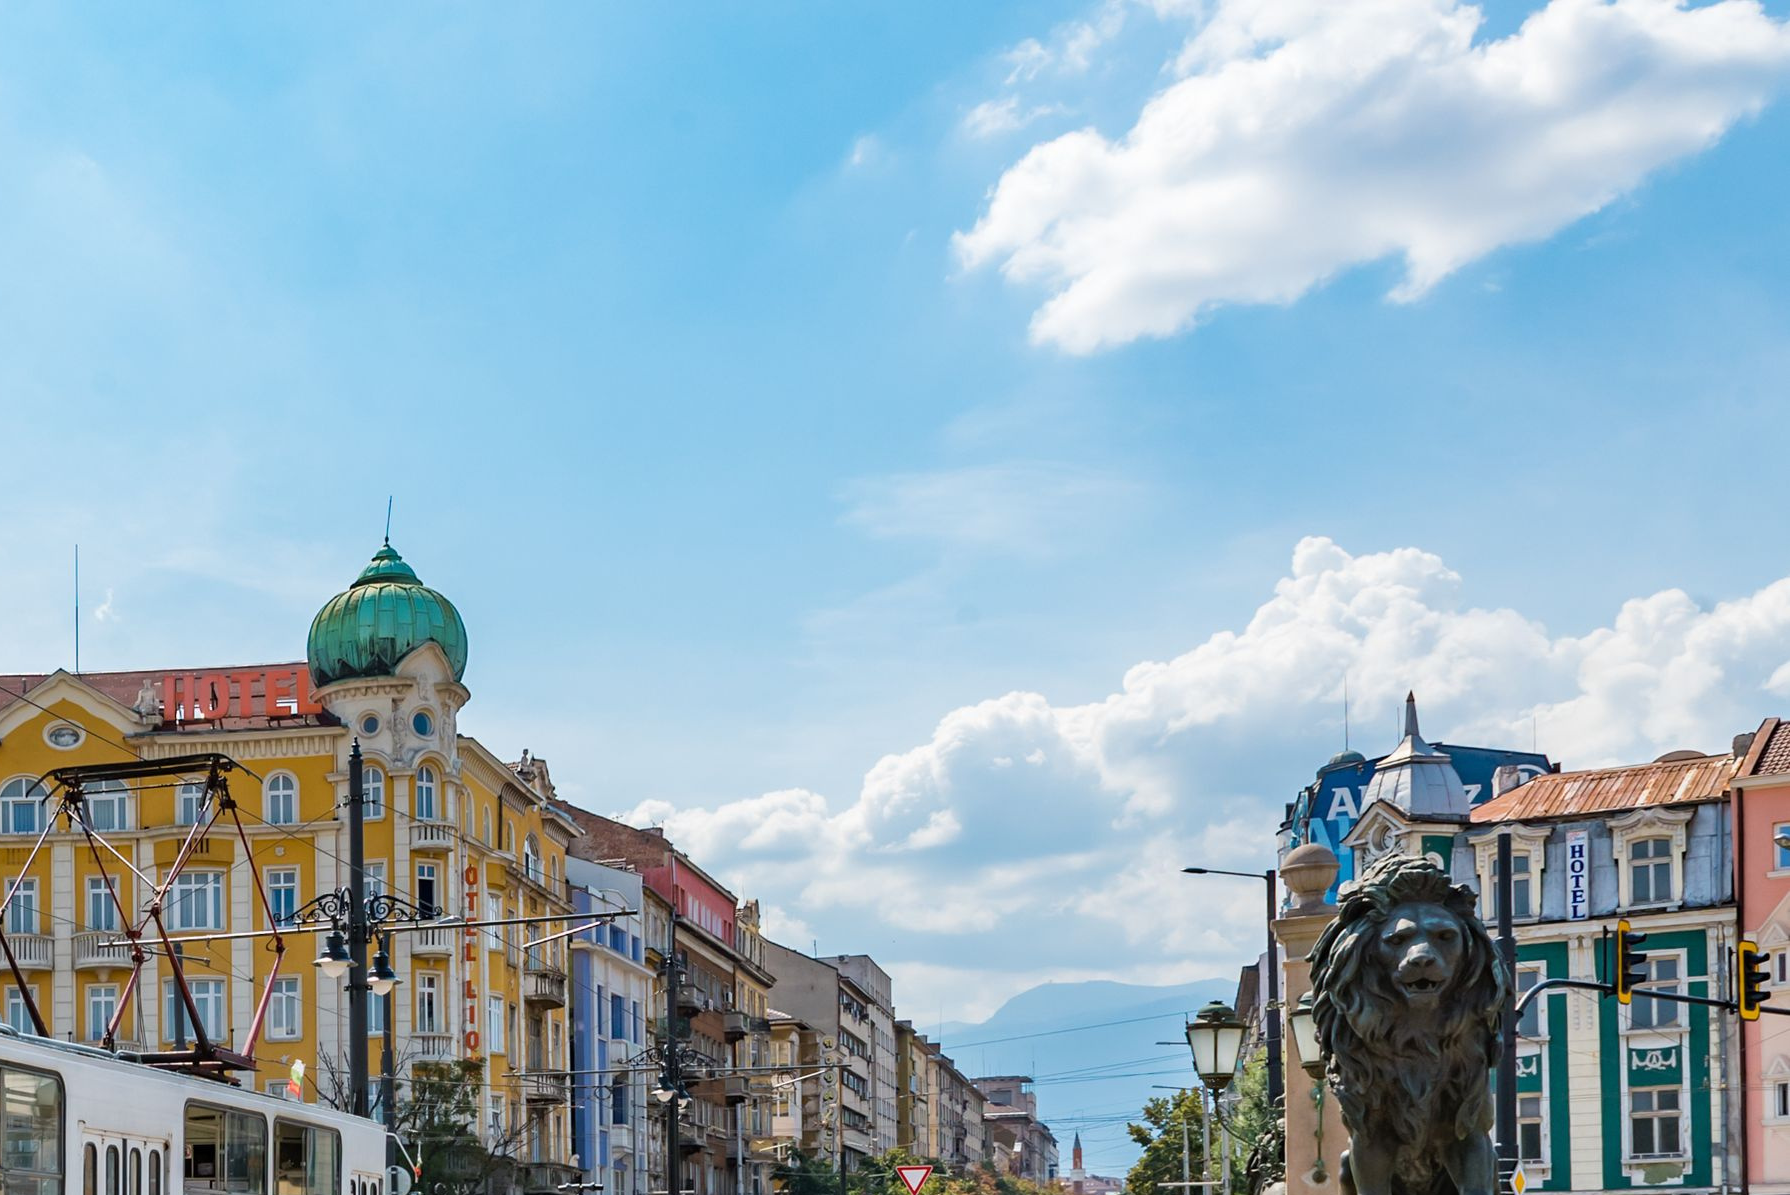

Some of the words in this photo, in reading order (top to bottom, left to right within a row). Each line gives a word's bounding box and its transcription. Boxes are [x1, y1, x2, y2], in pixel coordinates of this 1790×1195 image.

[164, 669, 322, 721] HOTEL
[1570, 844, 1586, 919] HOTEL
[466, 979, 479, 1052] LIO
